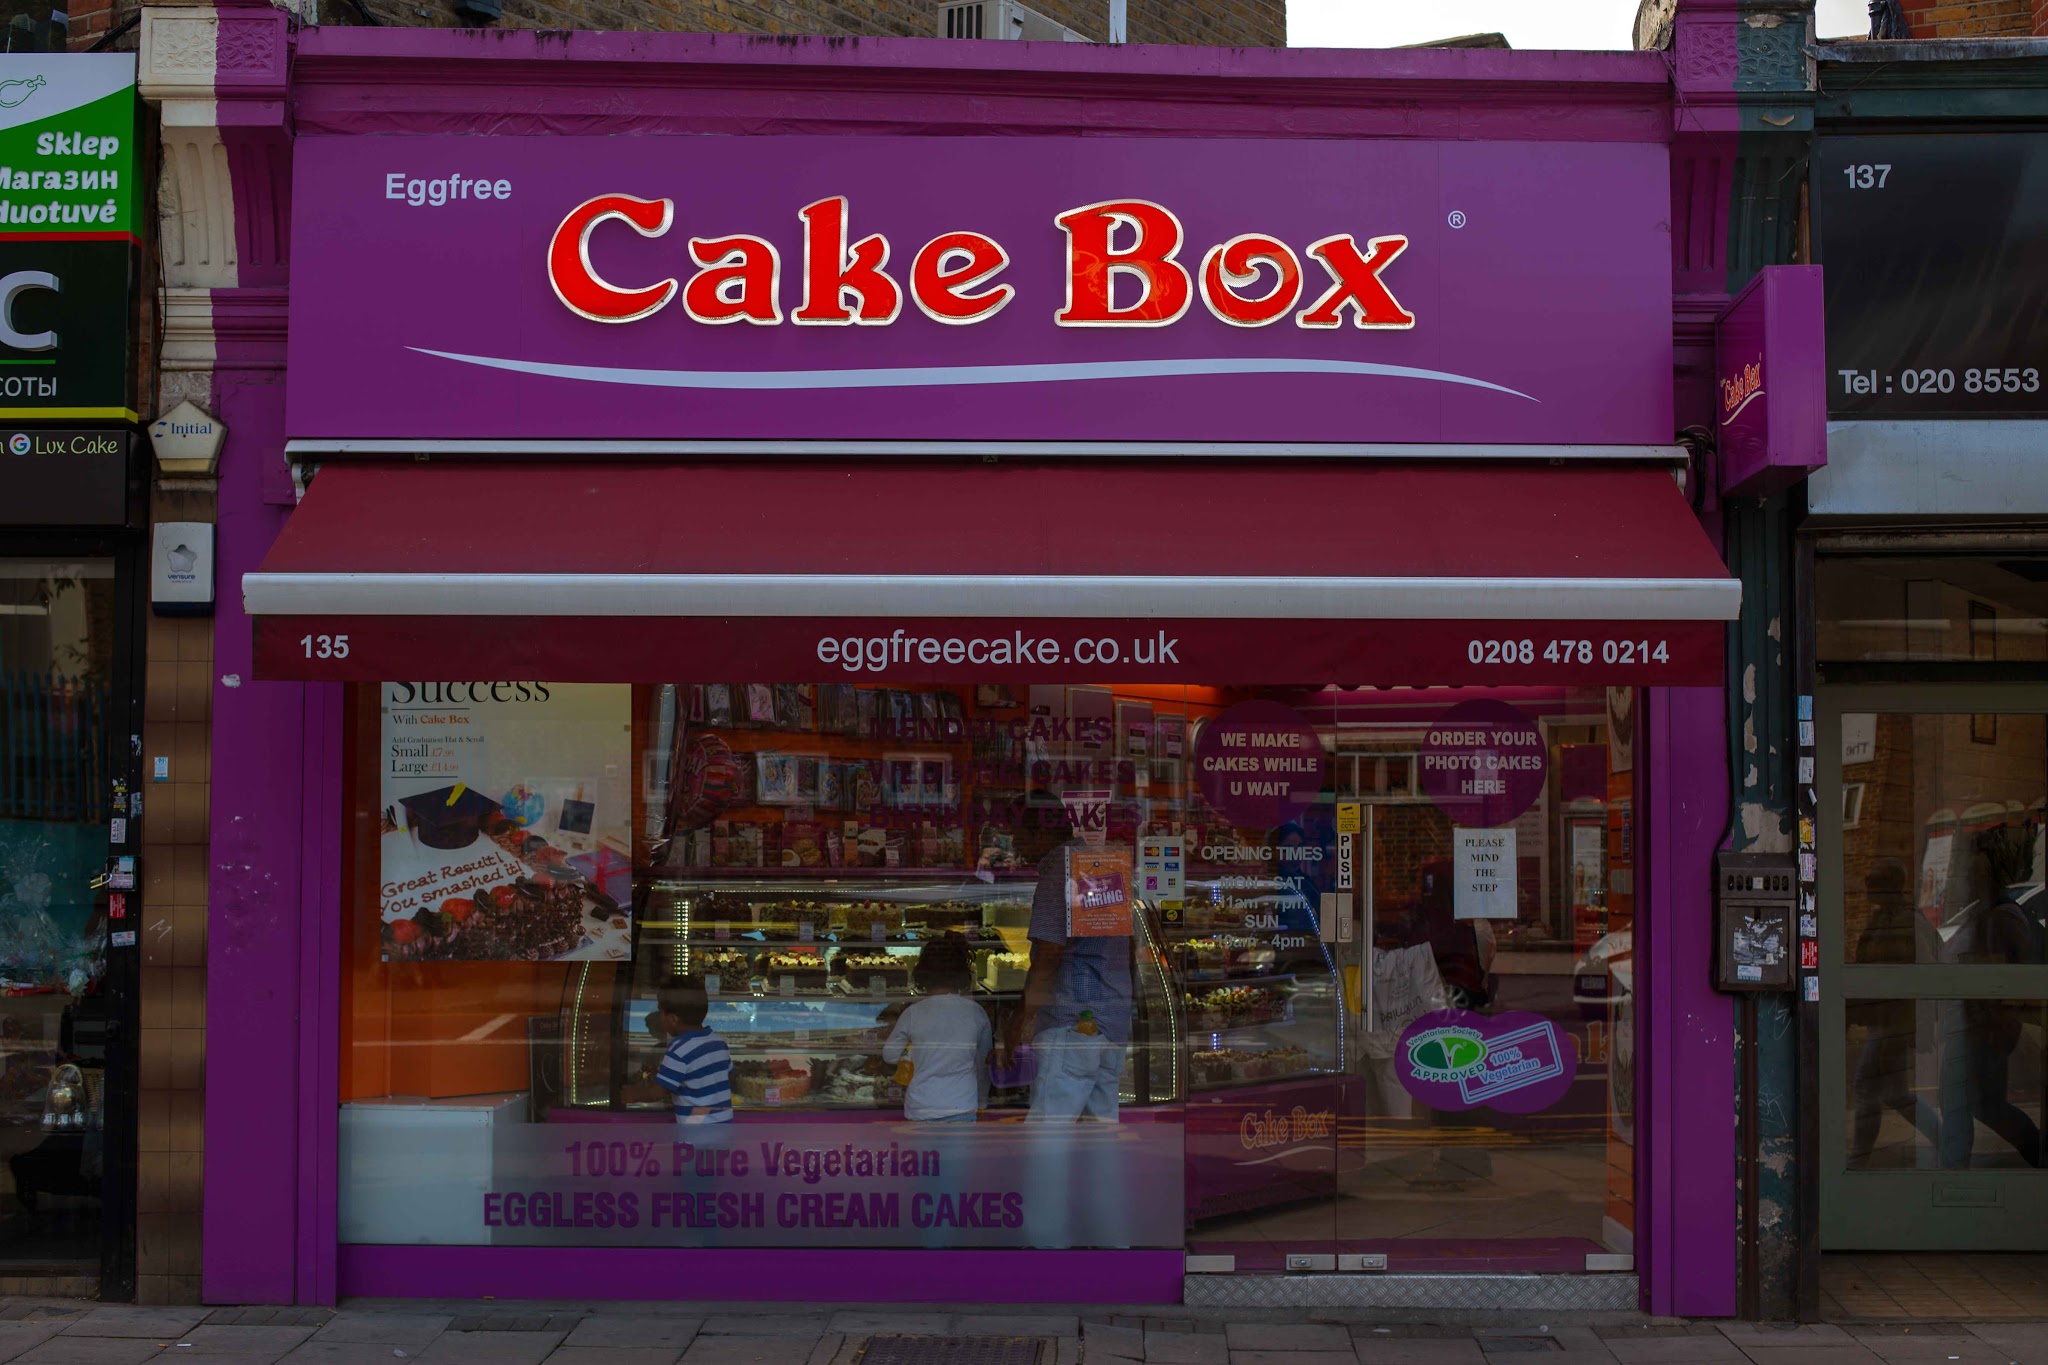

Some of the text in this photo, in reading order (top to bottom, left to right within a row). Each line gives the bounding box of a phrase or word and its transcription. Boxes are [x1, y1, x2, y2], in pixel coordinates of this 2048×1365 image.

[36, 131, 119, 160] Sklep
[1843, 164, 1892, 189] 137
[385, 173, 512, 207] Eggfree
[547, 193, 1416, 330] Cake Box
[1838, 369, 1877, 394] Tel
[1901, 368, 1955, 394] 020
[1963, 368, 2041, 393] 8553
[171, 423, 213, 434] Initial
[35, 436, 67, 455] Lux
[70, 435, 119, 455] Cake
[299, 635, 350, 659] 135
[816, 629, 1180, 671] eggfreecake.co.uk
[1467, 639, 1670, 664] 0208 478 0214
[392, 681, 550, 703] Success
[393, 714, 470, 725] With Cake Box
[870, 717, 1113, 742] MENDHI CAKES
[1429, 731, 1538, 746] ORDER YOUR
[1220, 732, 1300, 748] WE MAKE
[391, 744, 429, 758] Small
[392, 759, 429, 774] Large
[1203, 756, 1317, 773] CAKES WHILE
[1425, 755, 1542, 770] PHOTO CAKES
[870, 760, 1136, 785] WEDDING CAKES
[1229, 782, 1290, 796] U WAIT
[1460, 780, 1506, 795] HERE
[870, 803, 1143, 829] BIRTHDAY CAKES
[1465, 838, 1505, 847] PLEASE
[1201, 846, 1324, 861] OPENING TIMES
[1340, 835, 1350, 886] PUSH
[1470, 853, 1499, 862] MIND
[1474, 868, 1496, 877] THE
[381, 871, 438, 898] Great
[421, 868, 504, 903] smashed
[1220, 876, 1305, 890] MON SAT
[1471, 883, 1498, 892] STEP
[1273, 896, 1307, 912] 7pm
[1245, 915, 1279, 928] SUN
[1271, 934, 1305, 950] 4pm
[1408, 1027, 1481, 1047] Vegetarian Society
[1491, 1048, 1521, 1065] 100%
[1413, 1063, 1485, 1081] APPROVED
[1480, 1059, 1540, 1082] Vegetarian
[1240, 1105, 1329, 1150] Cake Box
[565, 1141, 941, 1184] 100% Pure Vegetarian
[483, 1192, 1025, 1229] EGGLESS FRESH CREAM CAKES
